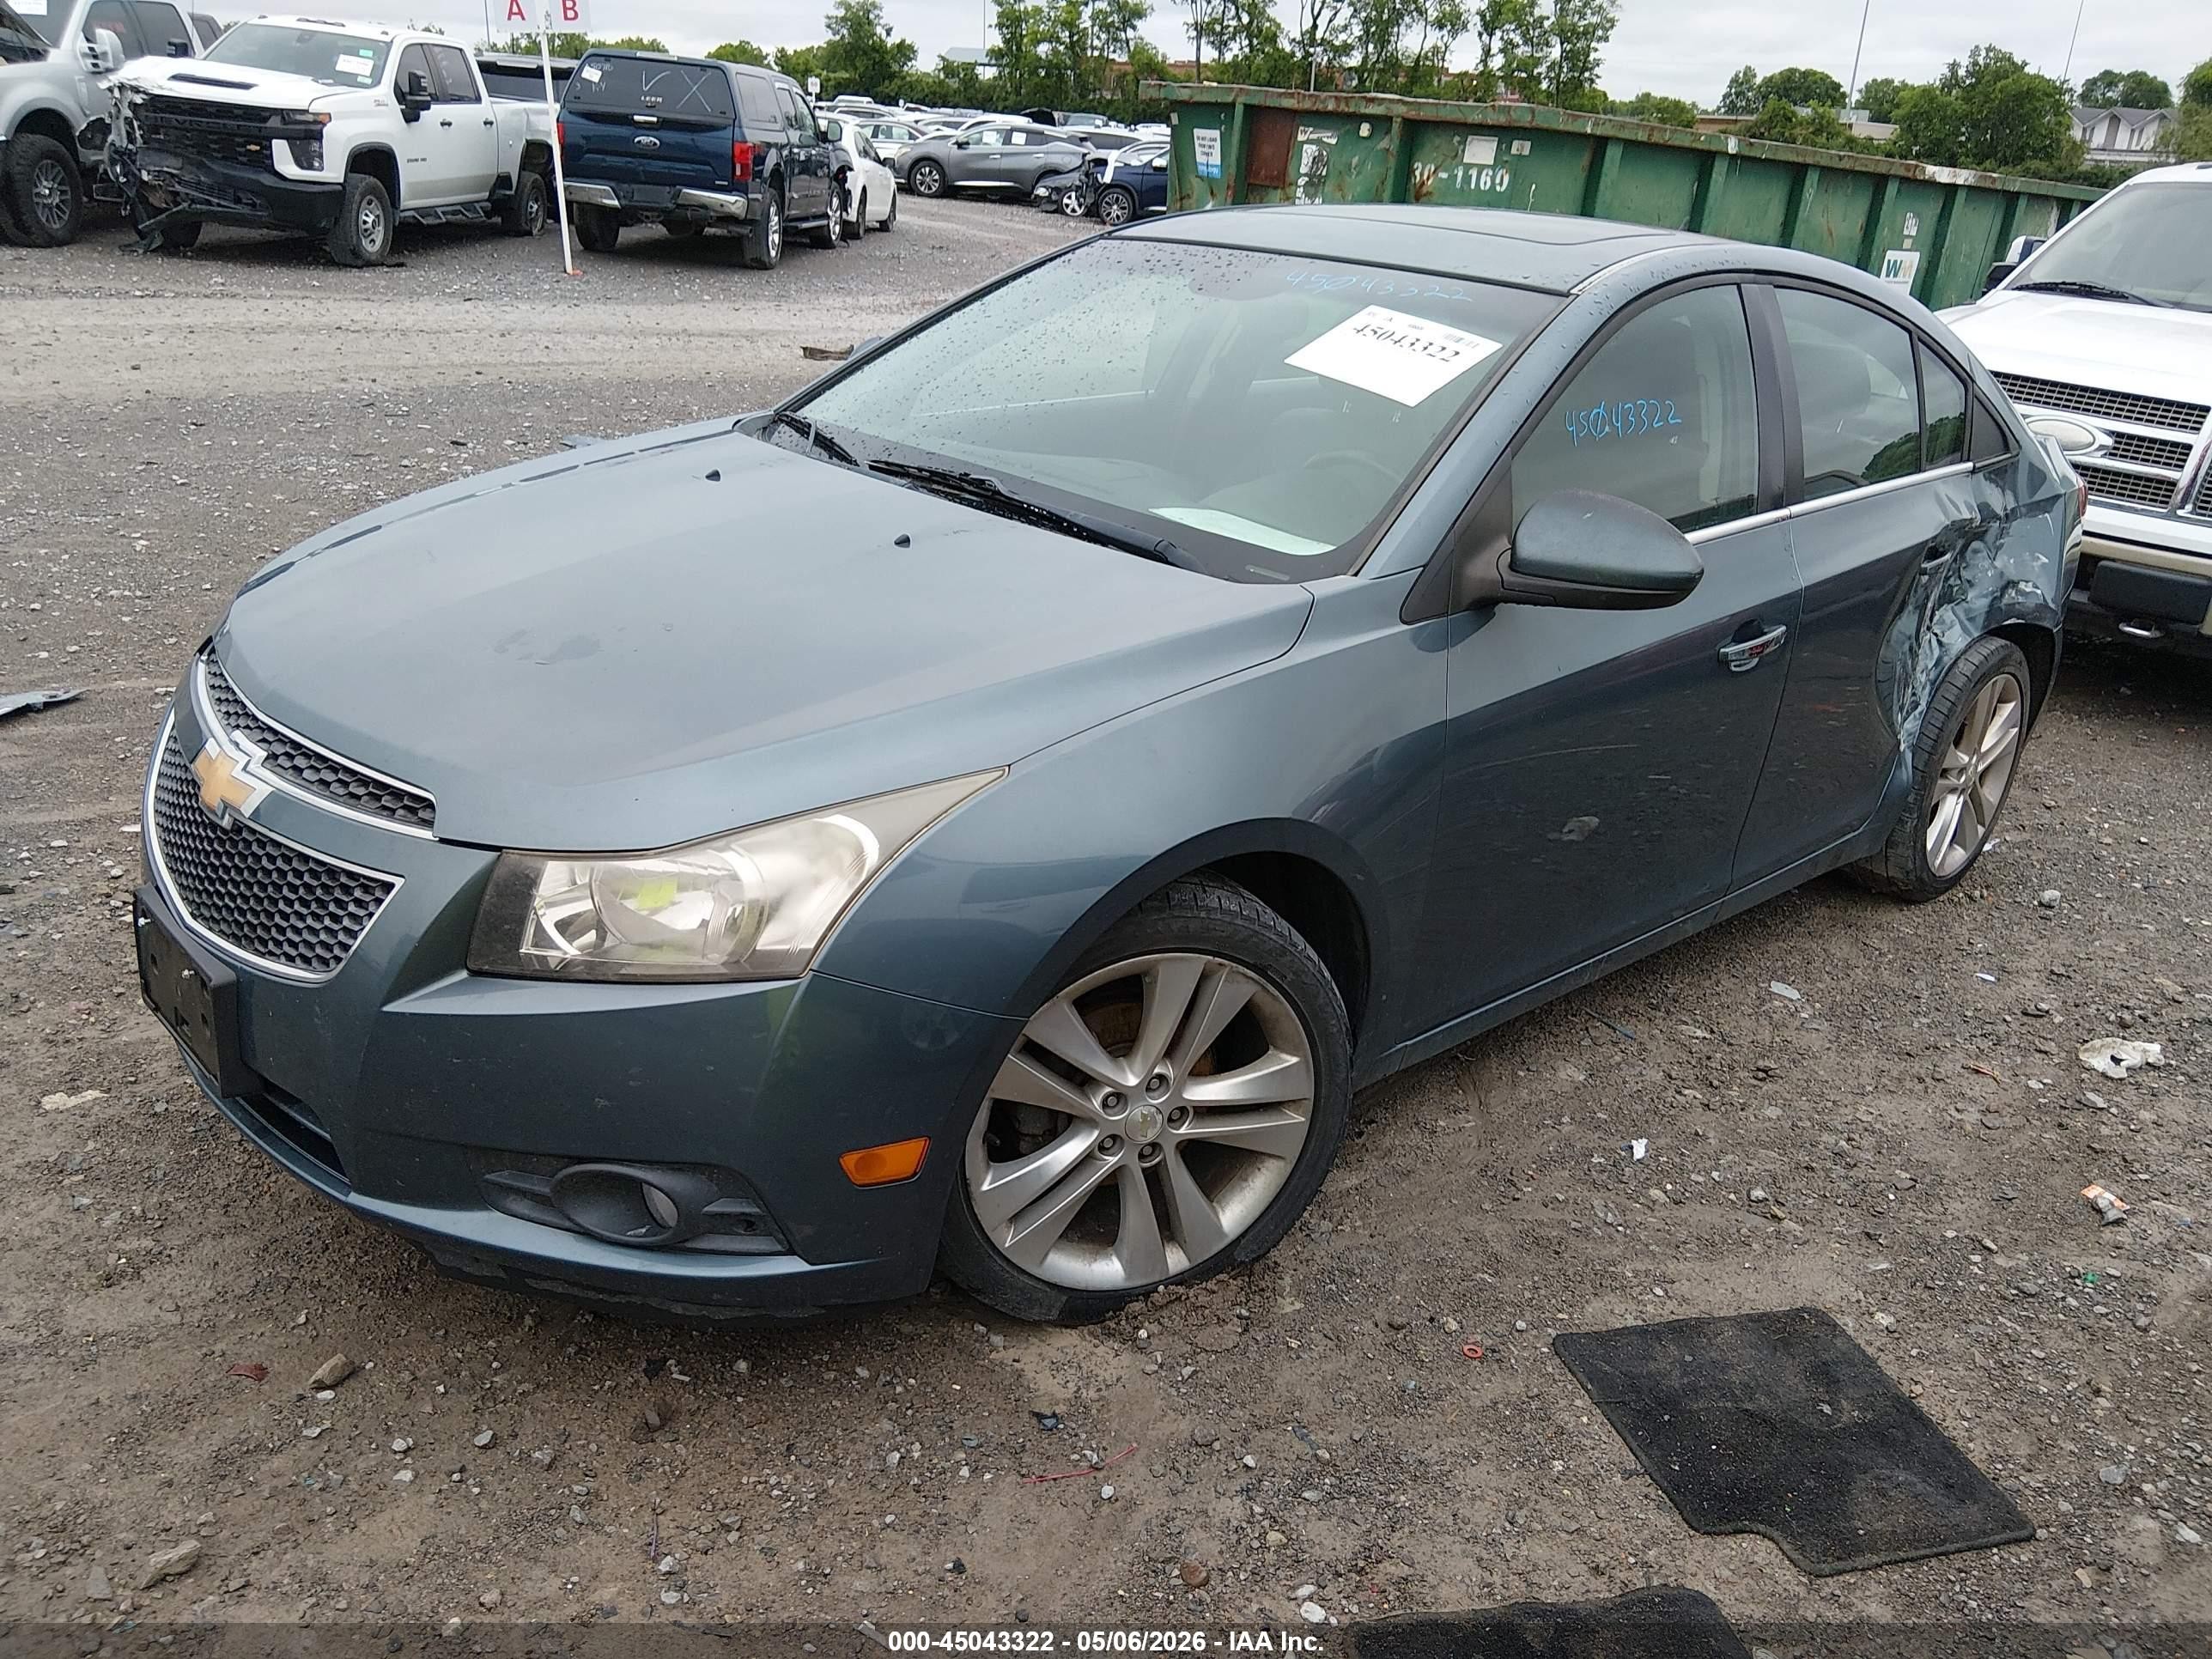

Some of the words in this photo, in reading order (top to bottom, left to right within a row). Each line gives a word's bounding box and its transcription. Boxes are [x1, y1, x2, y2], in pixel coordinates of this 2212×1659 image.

[507, 0, 526, 21] A
[562, 0, 580, 21] B
[1885, 259, 1913, 279] WM
[1353, 323, 1461, 362] 45043322
[1565, 398, 1684, 447] 45043322
